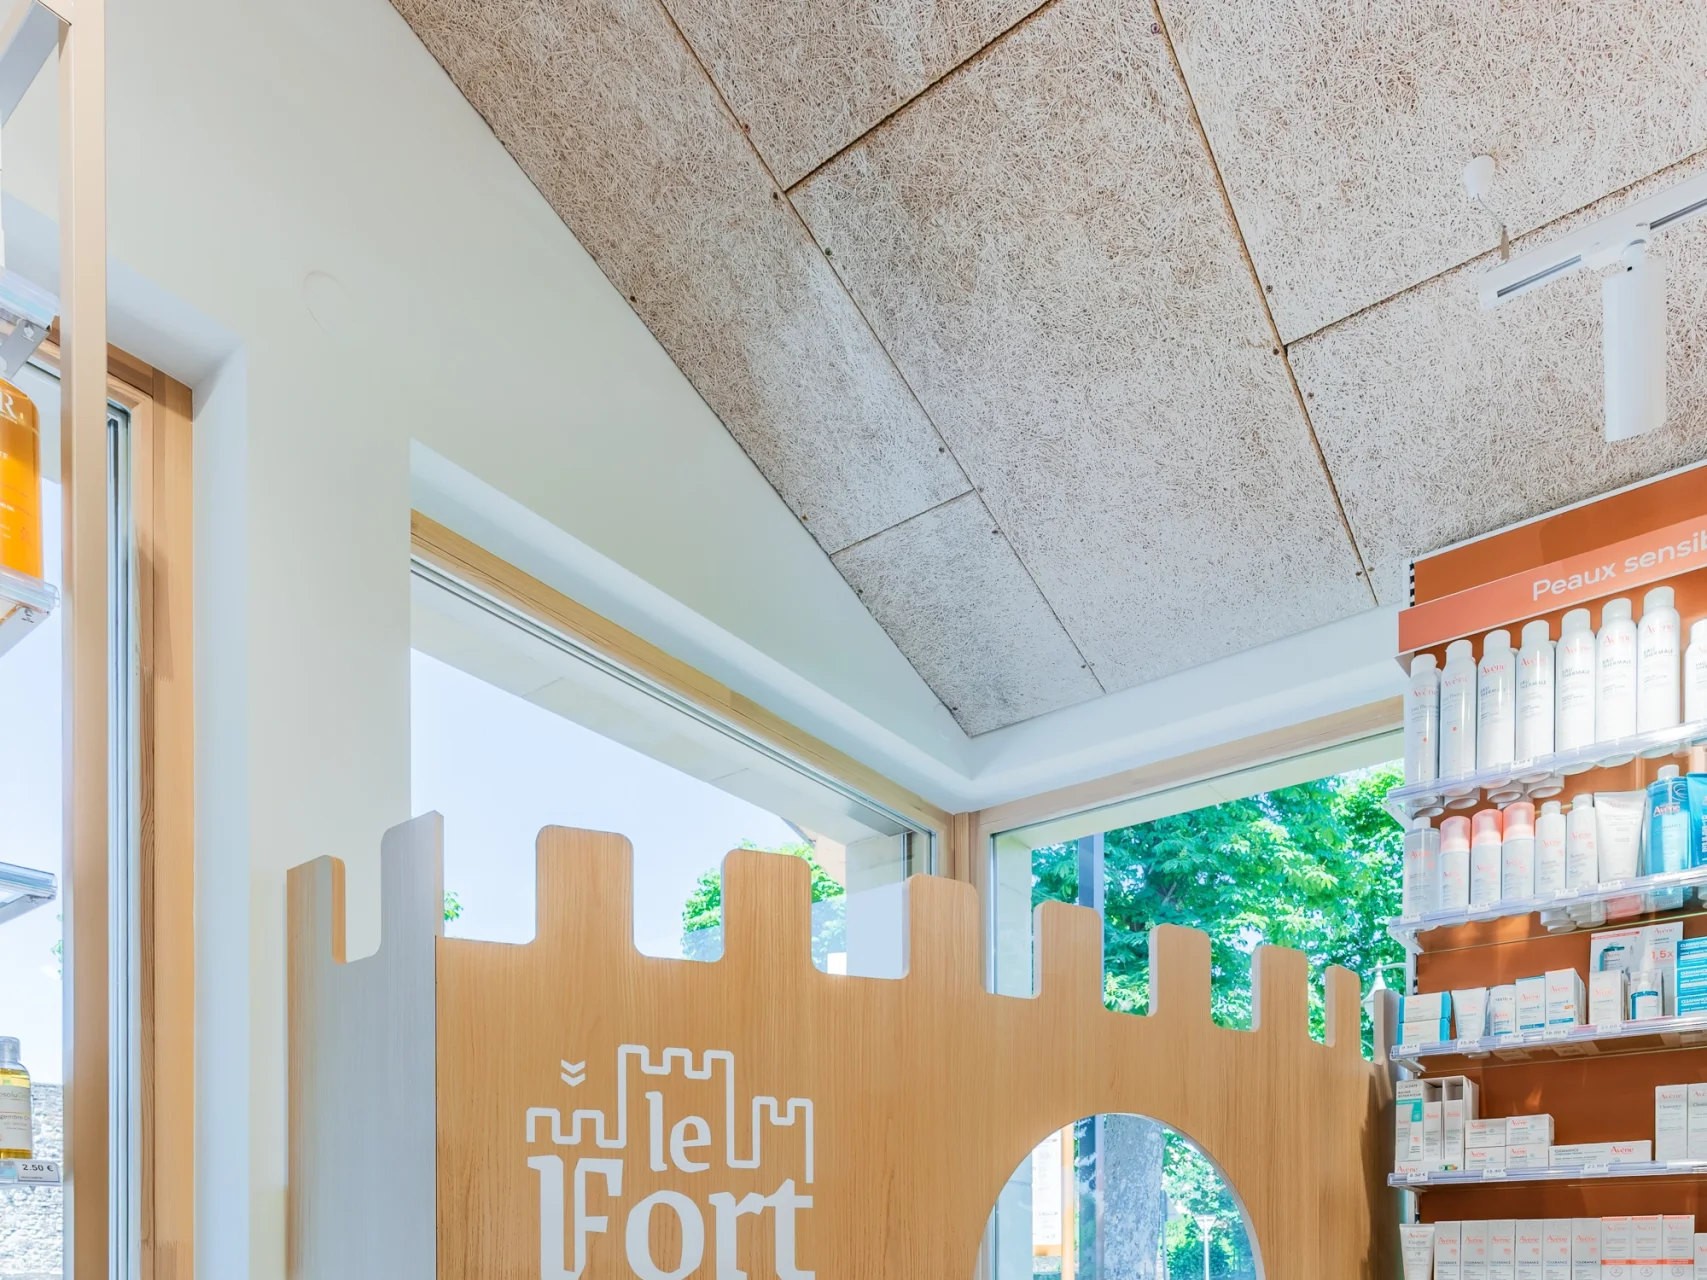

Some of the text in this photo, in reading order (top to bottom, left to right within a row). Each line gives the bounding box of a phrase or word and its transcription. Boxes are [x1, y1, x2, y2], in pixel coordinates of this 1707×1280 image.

[1533, 562, 1617, 601] Peaux
[645, 1091, 711, 1173] le
[1610, 1146, 1634, 1154] Avène
